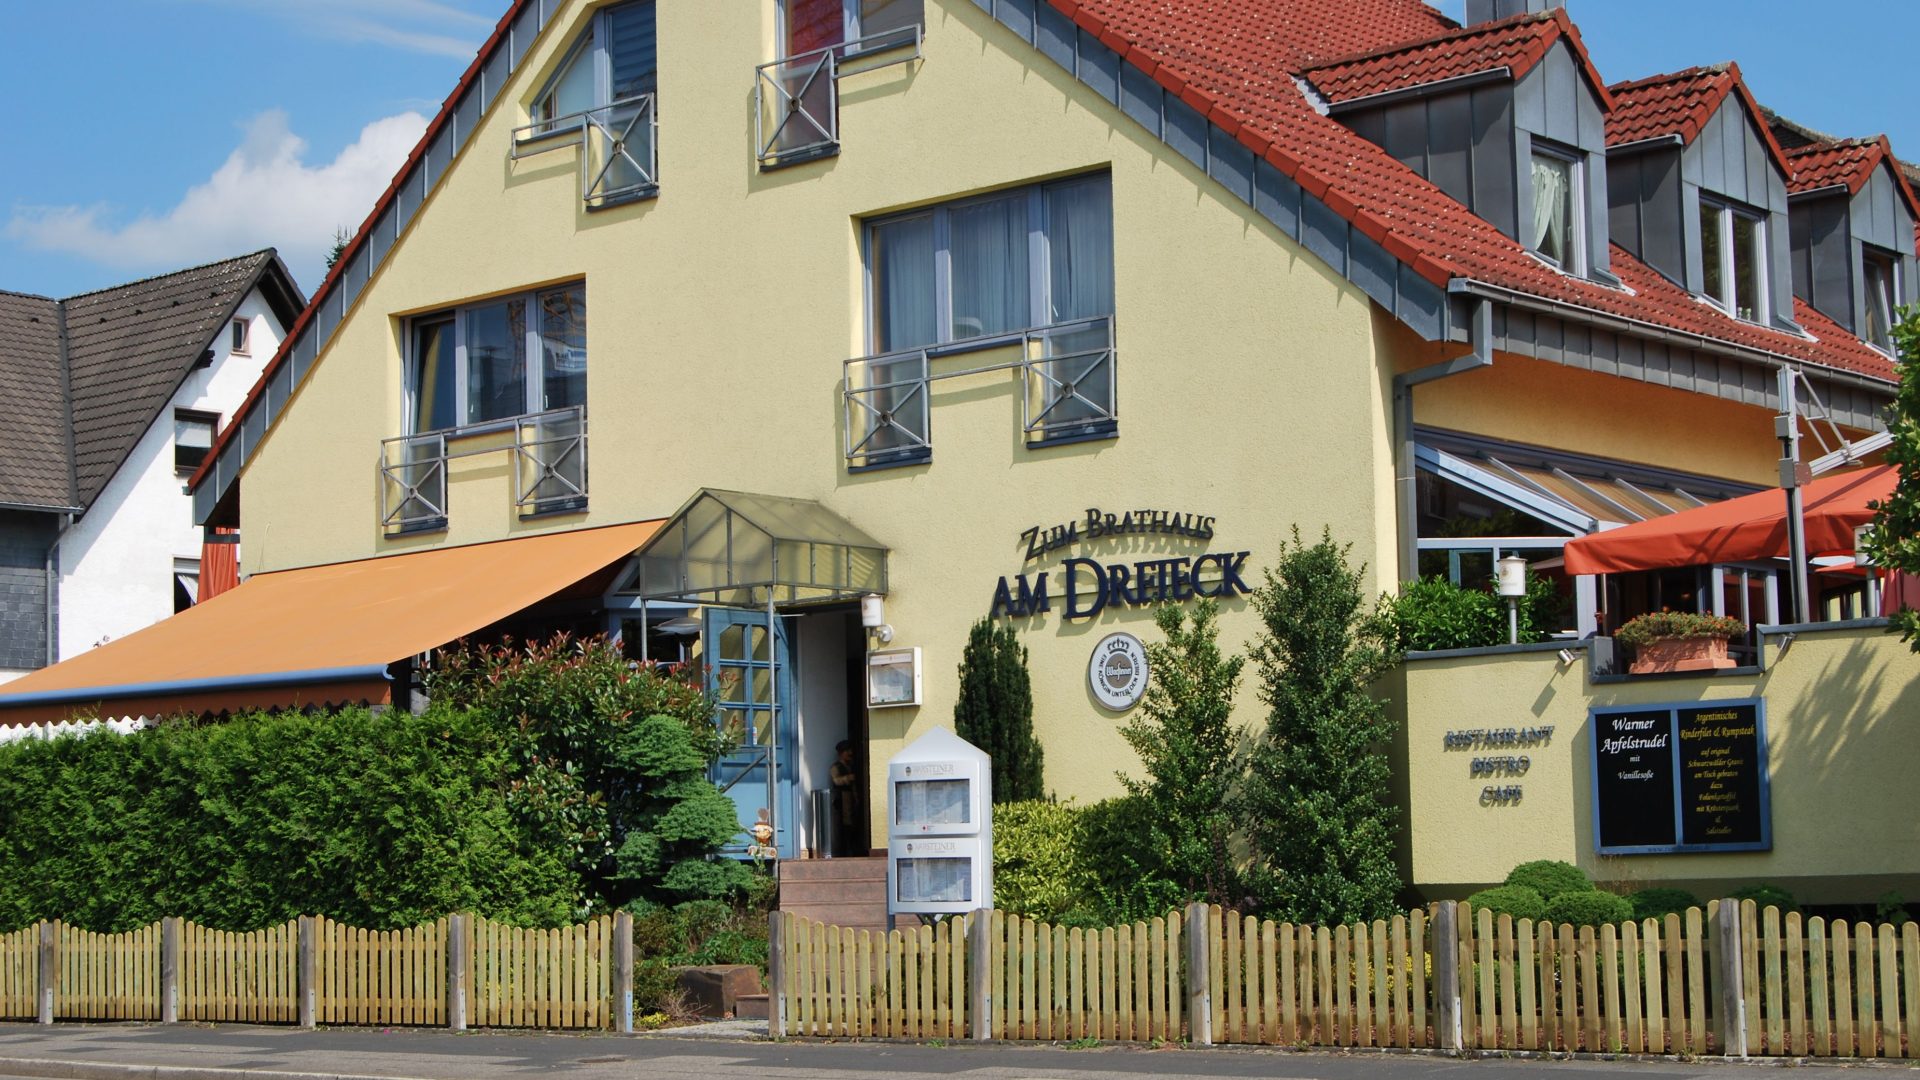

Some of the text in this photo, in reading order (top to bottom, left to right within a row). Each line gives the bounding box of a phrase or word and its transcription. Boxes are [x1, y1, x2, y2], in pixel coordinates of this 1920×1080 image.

[992, 572, 1051, 618] AM
[1129, 677, 1139, 691] DEN
[1612, 717, 1655, 731] Warmer
[1680, 726, 1712, 740] Rinderfilet
[1721, 724, 1755, 739] Rumpsteak
[1445, 726, 1555, 747] RESTAURANT
[1600, 733, 1668, 754] Apfelstrudel
[1471, 755, 1531, 774] BISTRO
[1629, 755, 1641, 763] mit
[1617, 769, 1654, 781] Vanillesoße
